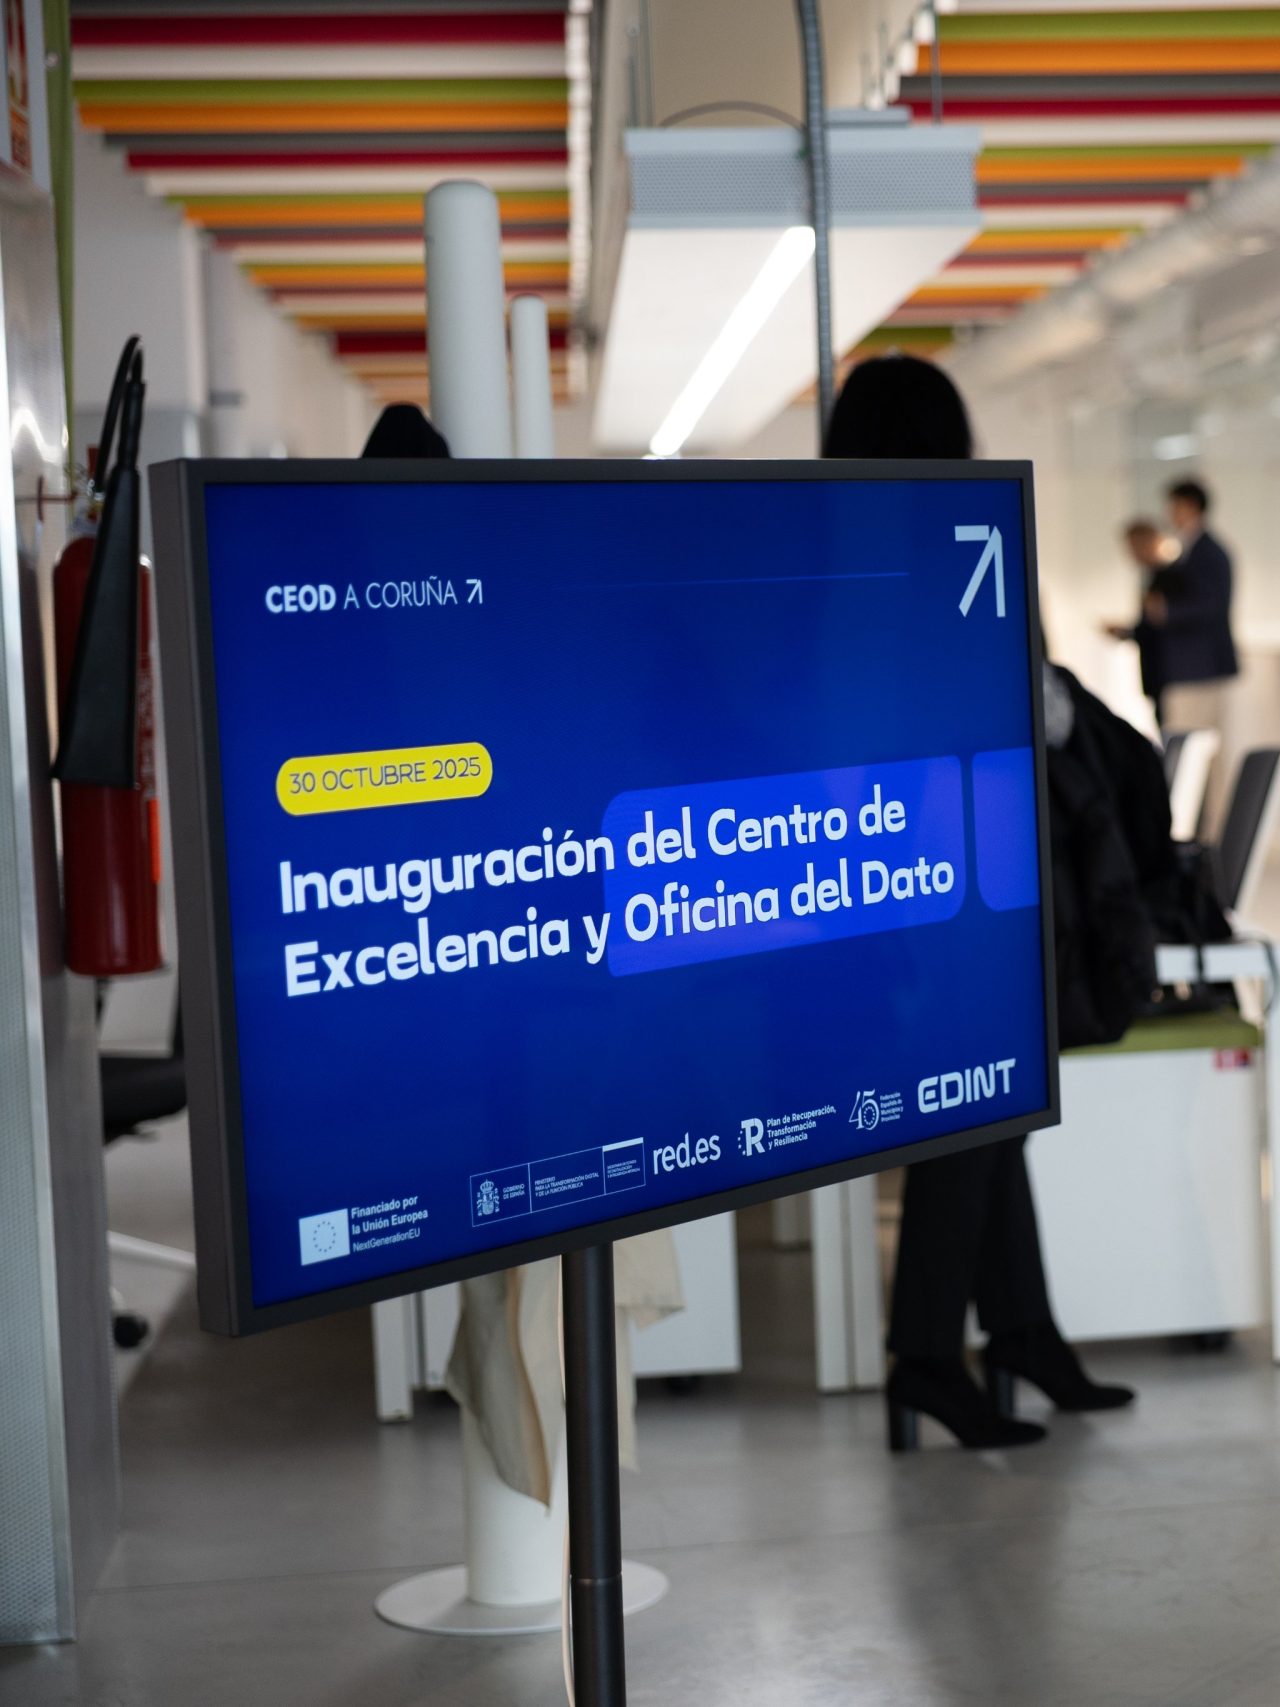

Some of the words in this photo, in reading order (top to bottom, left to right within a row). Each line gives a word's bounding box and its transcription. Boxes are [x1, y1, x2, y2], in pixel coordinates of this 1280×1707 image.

[265, 584, 336, 613] CEOD
[343, 583, 360, 610] A
[365, 575, 458, 609] CORUÑA
[289, 771, 316, 794] 30
[322, 761, 426, 791] OCTUBRE
[432, 756, 481, 780] 2025
[280, 827, 615, 914] Inauguración
[627, 806, 696, 867] del
[707, 804, 848, 856] Centro
[858, 784, 906, 836] de
[285, 906, 570, 997] Excelencia
[582, 912, 611, 964] y
[624, 879, 779, 942] Oficina
[790, 857, 852, 916] del
[861, 856, 954, 905] Dato
[918, 1058, 1016, 1114] EDINT
[766, 1118, 781, 1127] Plan
[782, 1114, 791, 1124] de
[792, 1105, 836, 1122] Recuperación,
[767, 1120, 816, 1138] Transformación
[653, 1131, 721, 1175] red.es
[768, 1141, 773, 1150] y
[774, 1132, 808, 1147] Resiliencia
[351, 1199, 401, 1219] Financiado
[402, 1196, 418, 1210] por
[352, 1224, 361, 1235] la
[362, 1218, 390, 1232] Unión
[391, 1209, 429, 1226] Europea
[352, 1227, 421, 1252] NextGenerationEU
